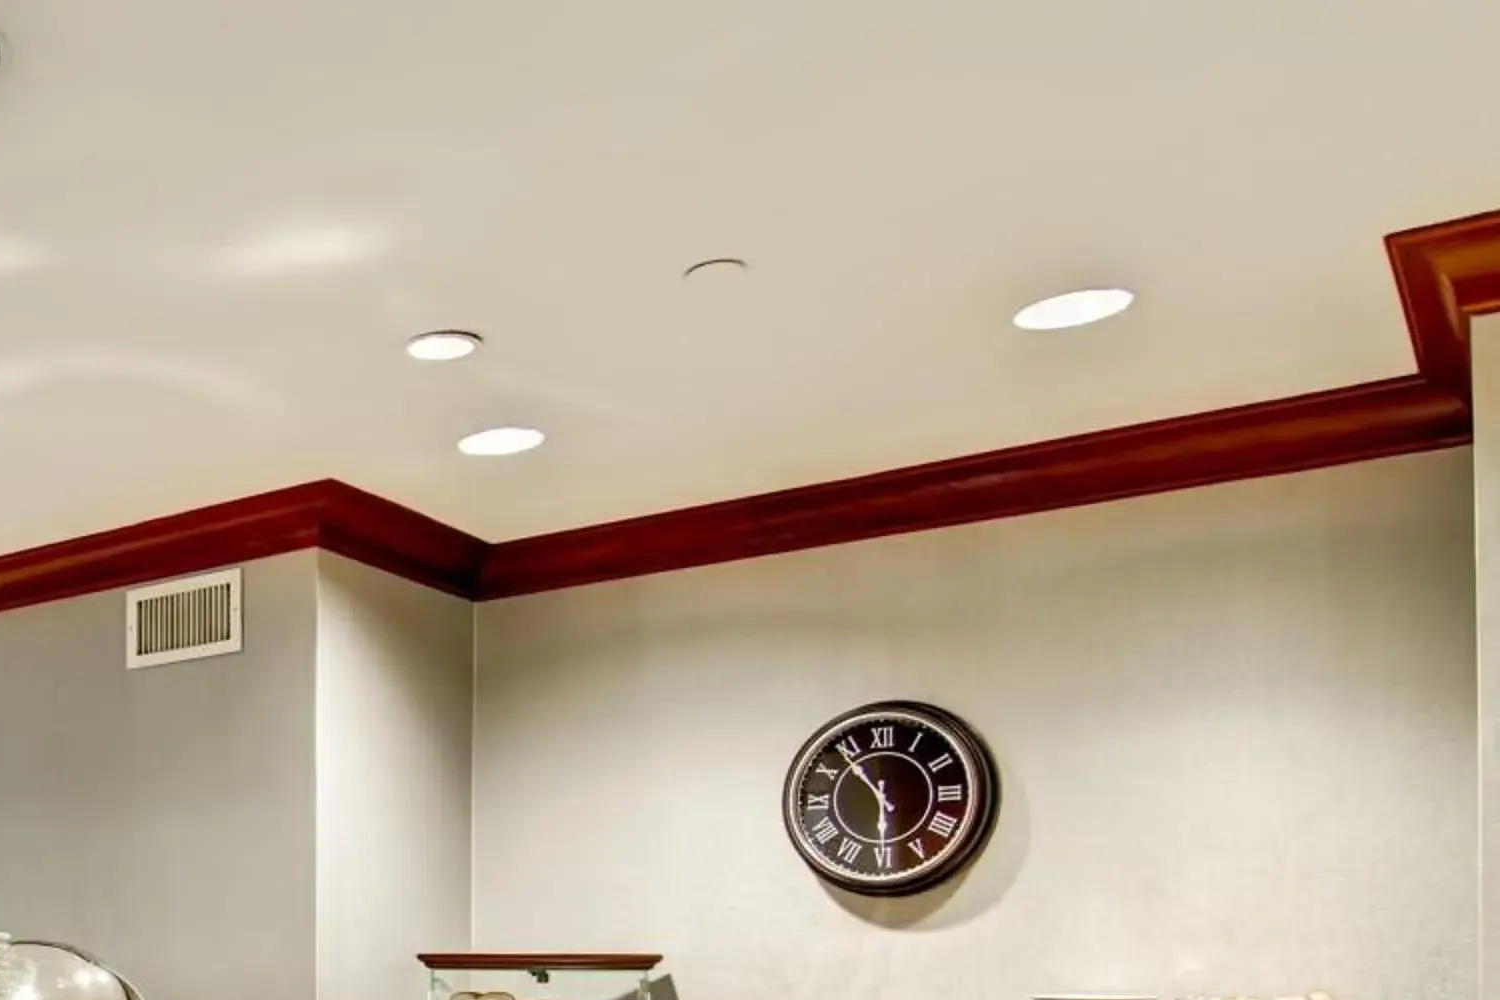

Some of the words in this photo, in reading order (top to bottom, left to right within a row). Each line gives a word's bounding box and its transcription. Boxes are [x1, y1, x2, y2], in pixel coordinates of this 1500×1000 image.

[870, 726, 894, 749] XII
[908, 732, 923, 752] I
[815, 762, 838, 780] X
[928, 753, 953, 773] II
[807, 794, 829, 810] IX
[937, 784, 962, 802] III
[812, 816, 839, 844] VIII
[837, 837, 862, 863] VII
[874, 847, 892, 868] VI
[908, 838, 925, 859] V
